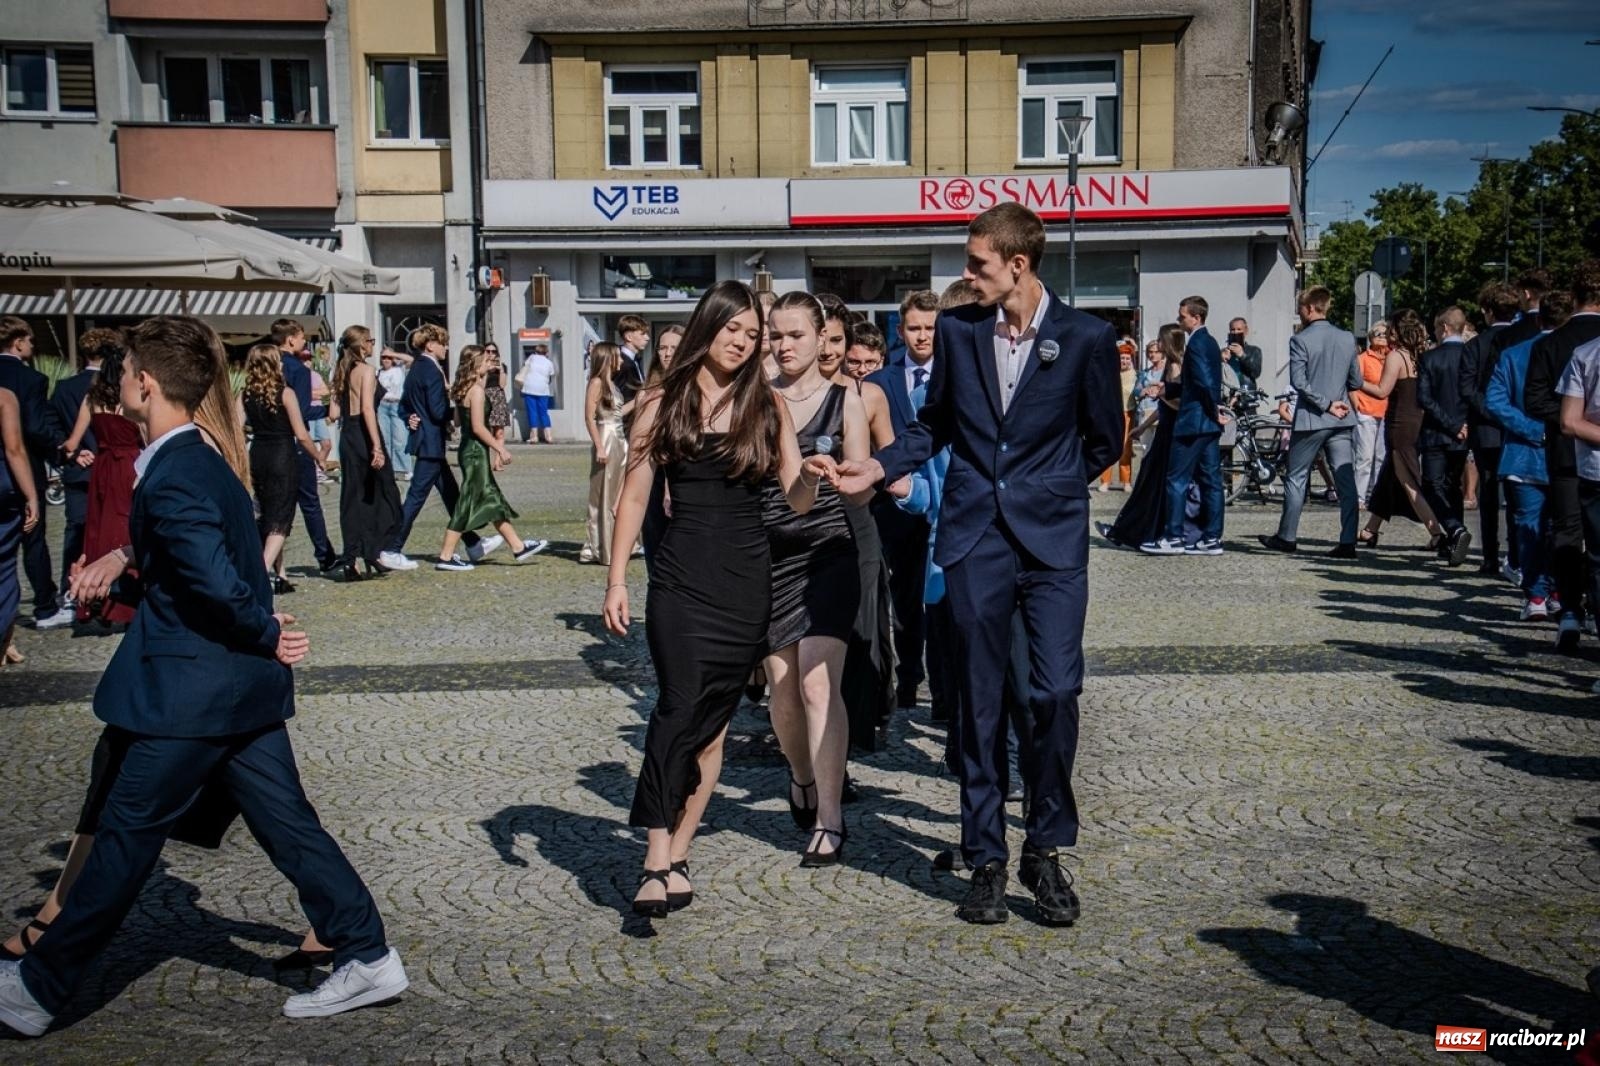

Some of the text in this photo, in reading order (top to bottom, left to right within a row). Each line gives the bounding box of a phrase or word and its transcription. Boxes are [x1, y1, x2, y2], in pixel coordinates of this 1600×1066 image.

[632, 186, 679, 204] TEB
[920, 175, 1149, 211] ROSSMANN
[632, 207, 680, 215] EDUKACJA
